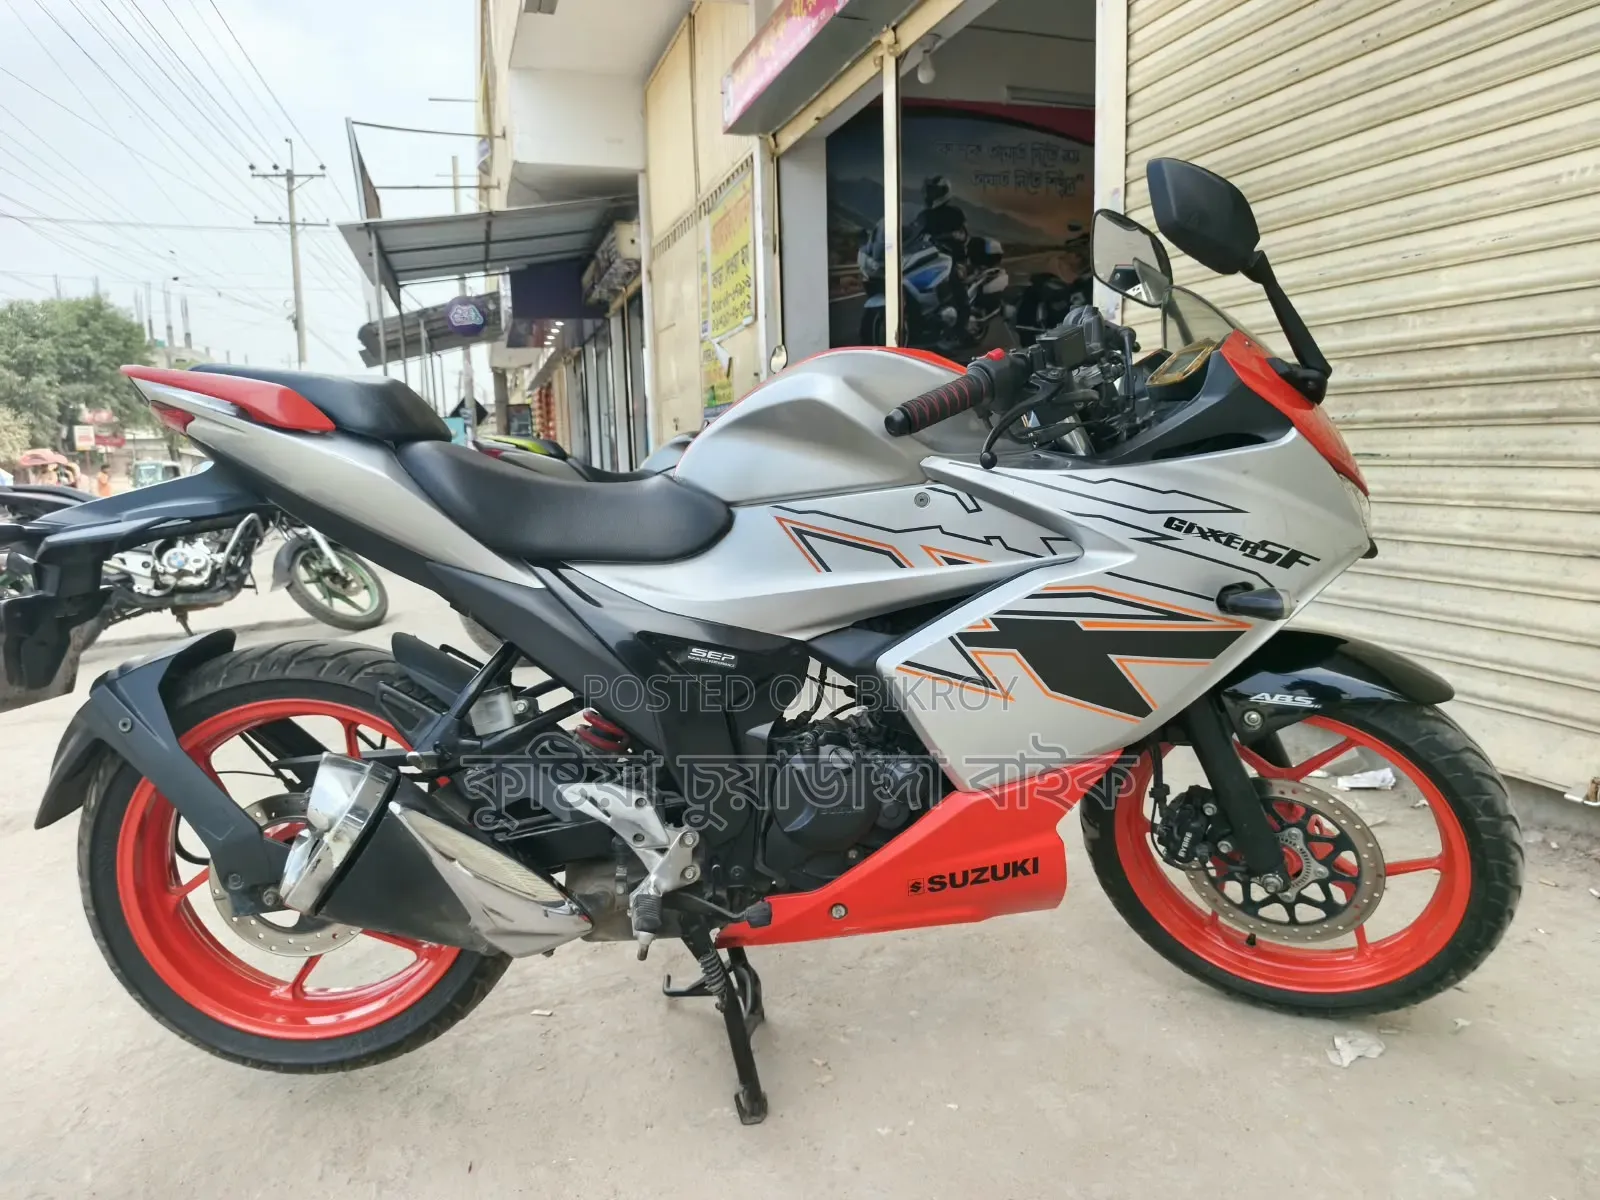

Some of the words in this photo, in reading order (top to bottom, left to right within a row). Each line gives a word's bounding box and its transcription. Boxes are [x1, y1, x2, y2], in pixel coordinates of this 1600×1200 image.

[689, 648, 735, 661] SEP
[1249, 692, 1316, 706] ABS
[927, 856, 1039, 893] SUZUKI
